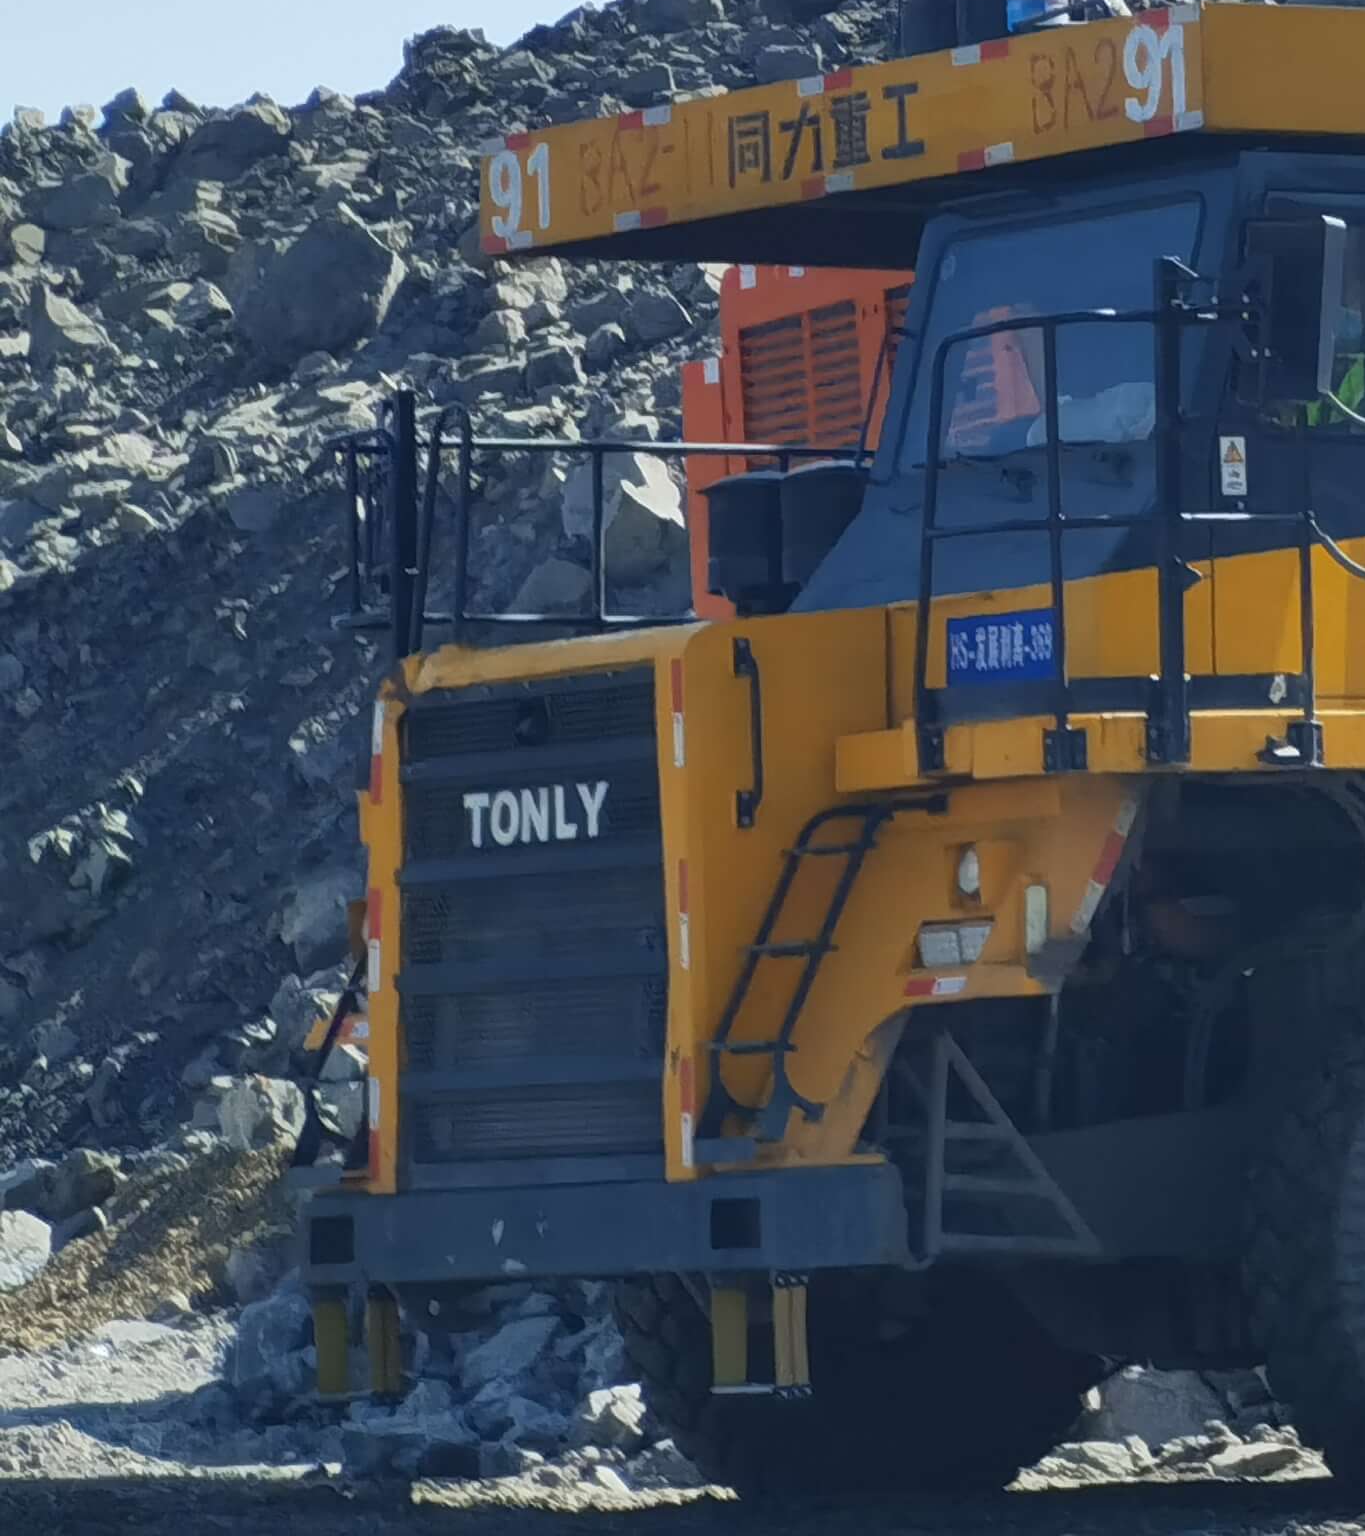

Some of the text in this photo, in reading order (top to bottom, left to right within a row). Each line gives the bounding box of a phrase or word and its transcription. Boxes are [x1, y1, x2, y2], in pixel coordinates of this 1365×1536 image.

[1123, 24, 1204, 132] 91
[728, 81, 926, 190] 同力重工
[488, 142, 551, 249] 91
[462, 780, 609, 848] TONLY
